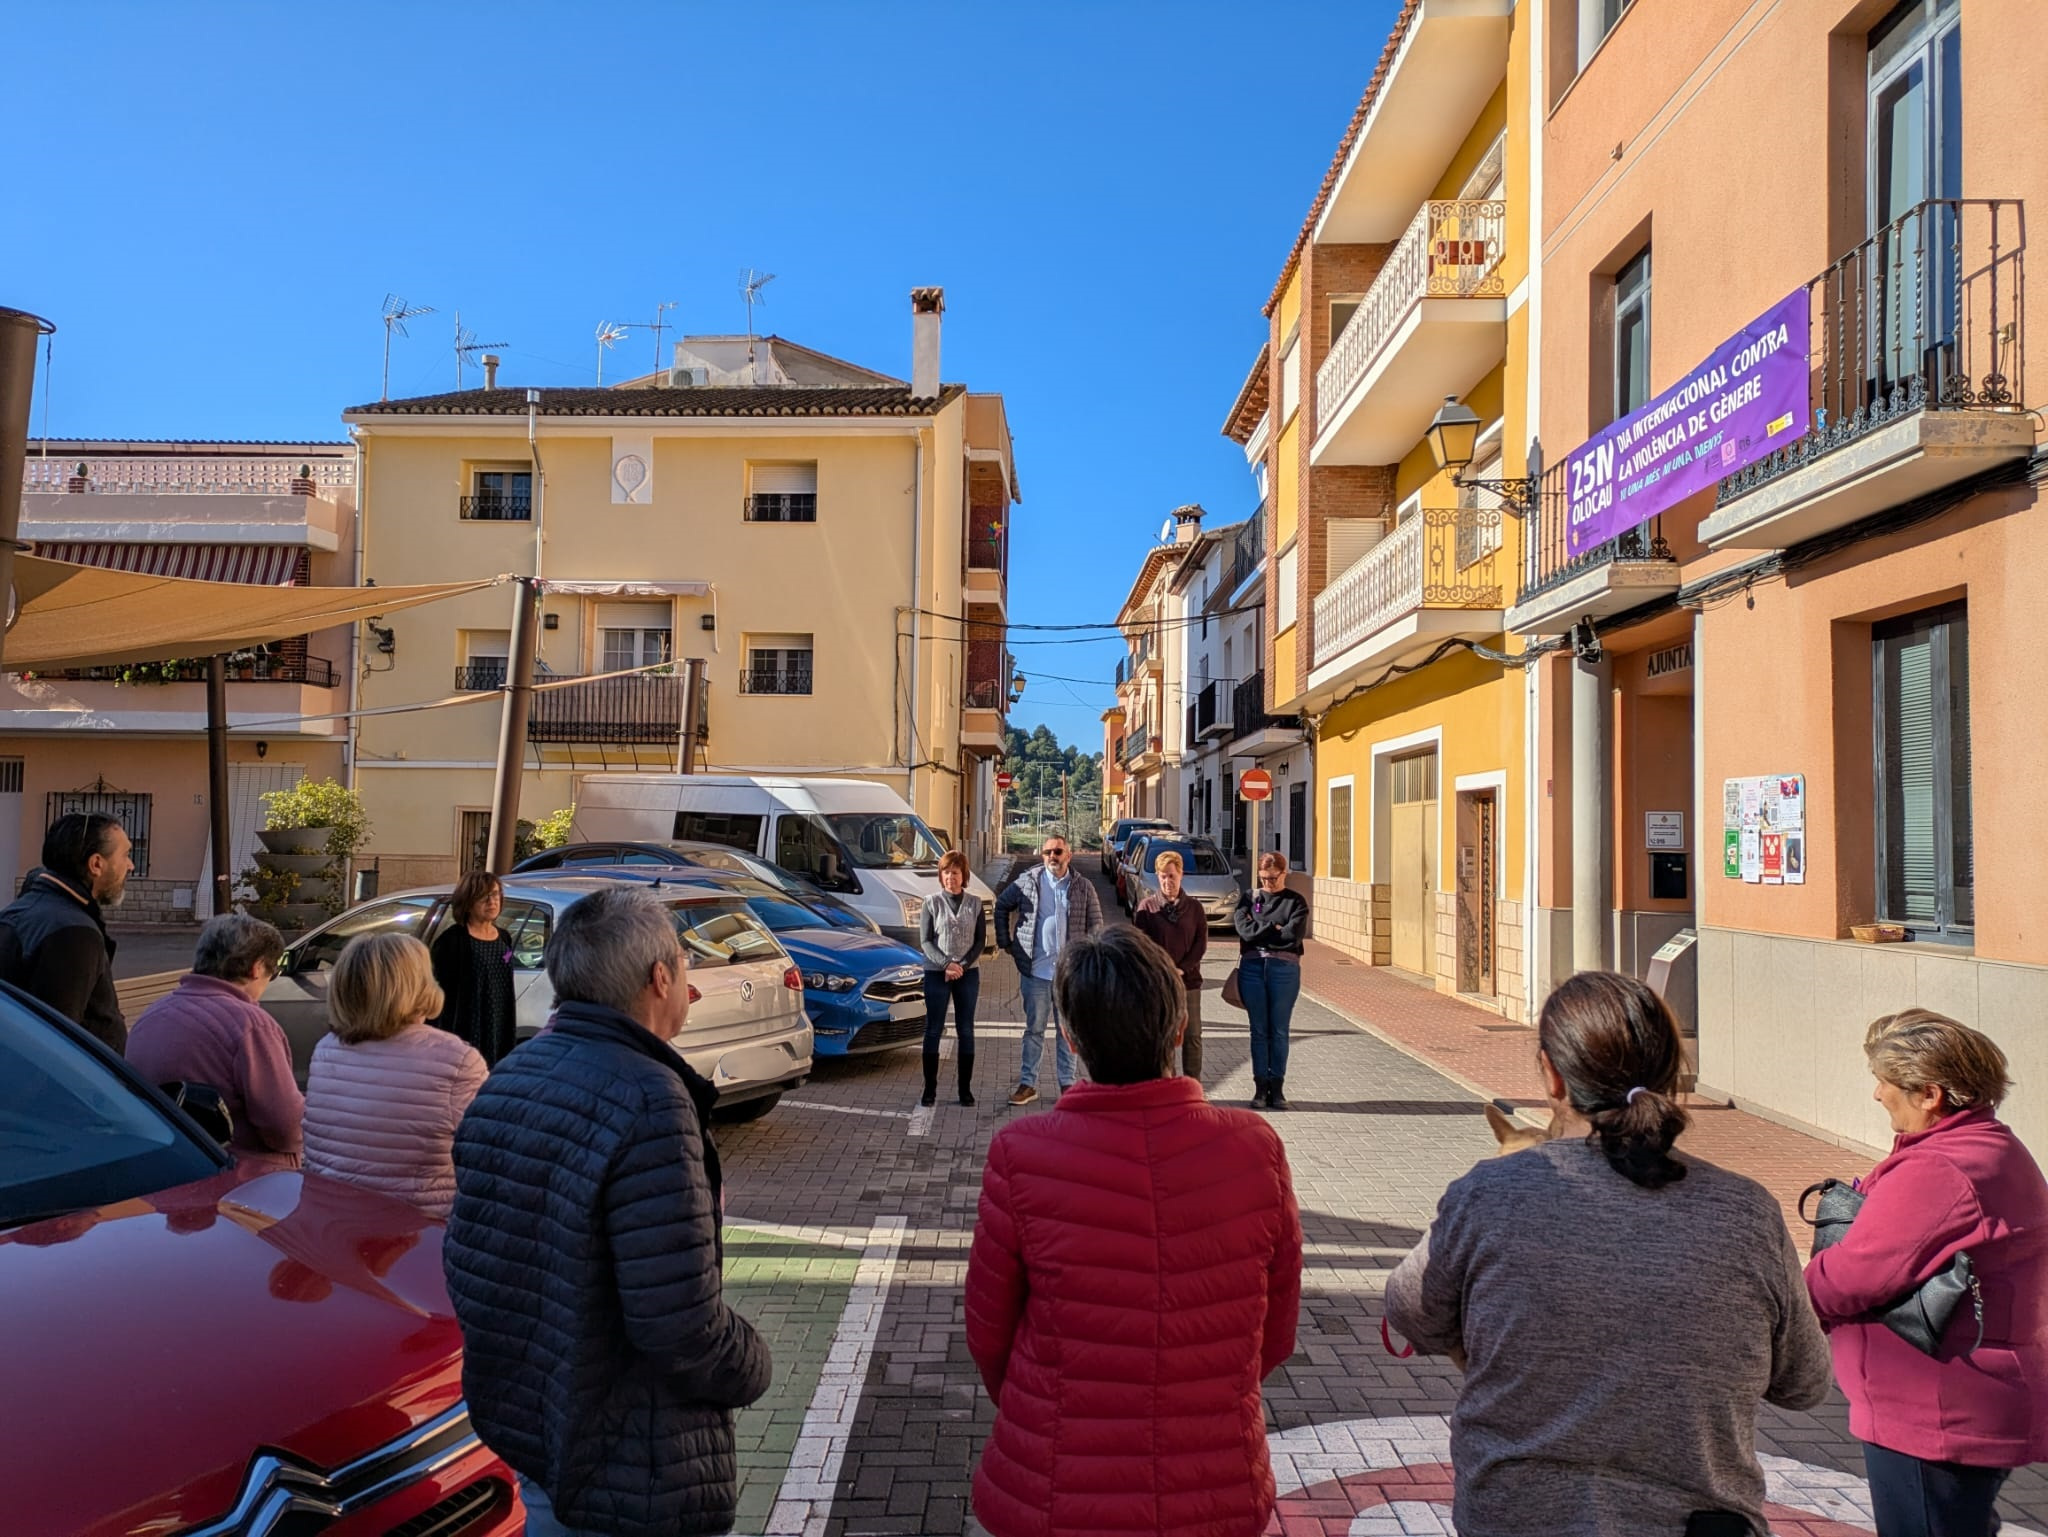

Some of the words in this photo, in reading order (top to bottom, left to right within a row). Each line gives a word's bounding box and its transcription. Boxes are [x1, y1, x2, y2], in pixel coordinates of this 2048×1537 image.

[1616, 428, 1633, 454] DIA
[1633, 365, 1728, 441] INTERNACIONAL
[1731, 323, 1788, 378] CONTRA
[1618, 459, 1632, 482] LA
[1632, 424, 1686, 473] VIOLÈNCIA
[1688, 409, 1708, 437] DE
[1710, 374, 1761, 423] GÈNERE
[1572, 438, 1615, 502] 25N
[1627, 478, 1643, 496] UNA
[1662, 460, 1672, 477] NI
[1672, 450, 1693, 470] UNA
[1694, 430, 1724, 459] MENYS
[1572, 482, 1612, 526] OLOCAU
